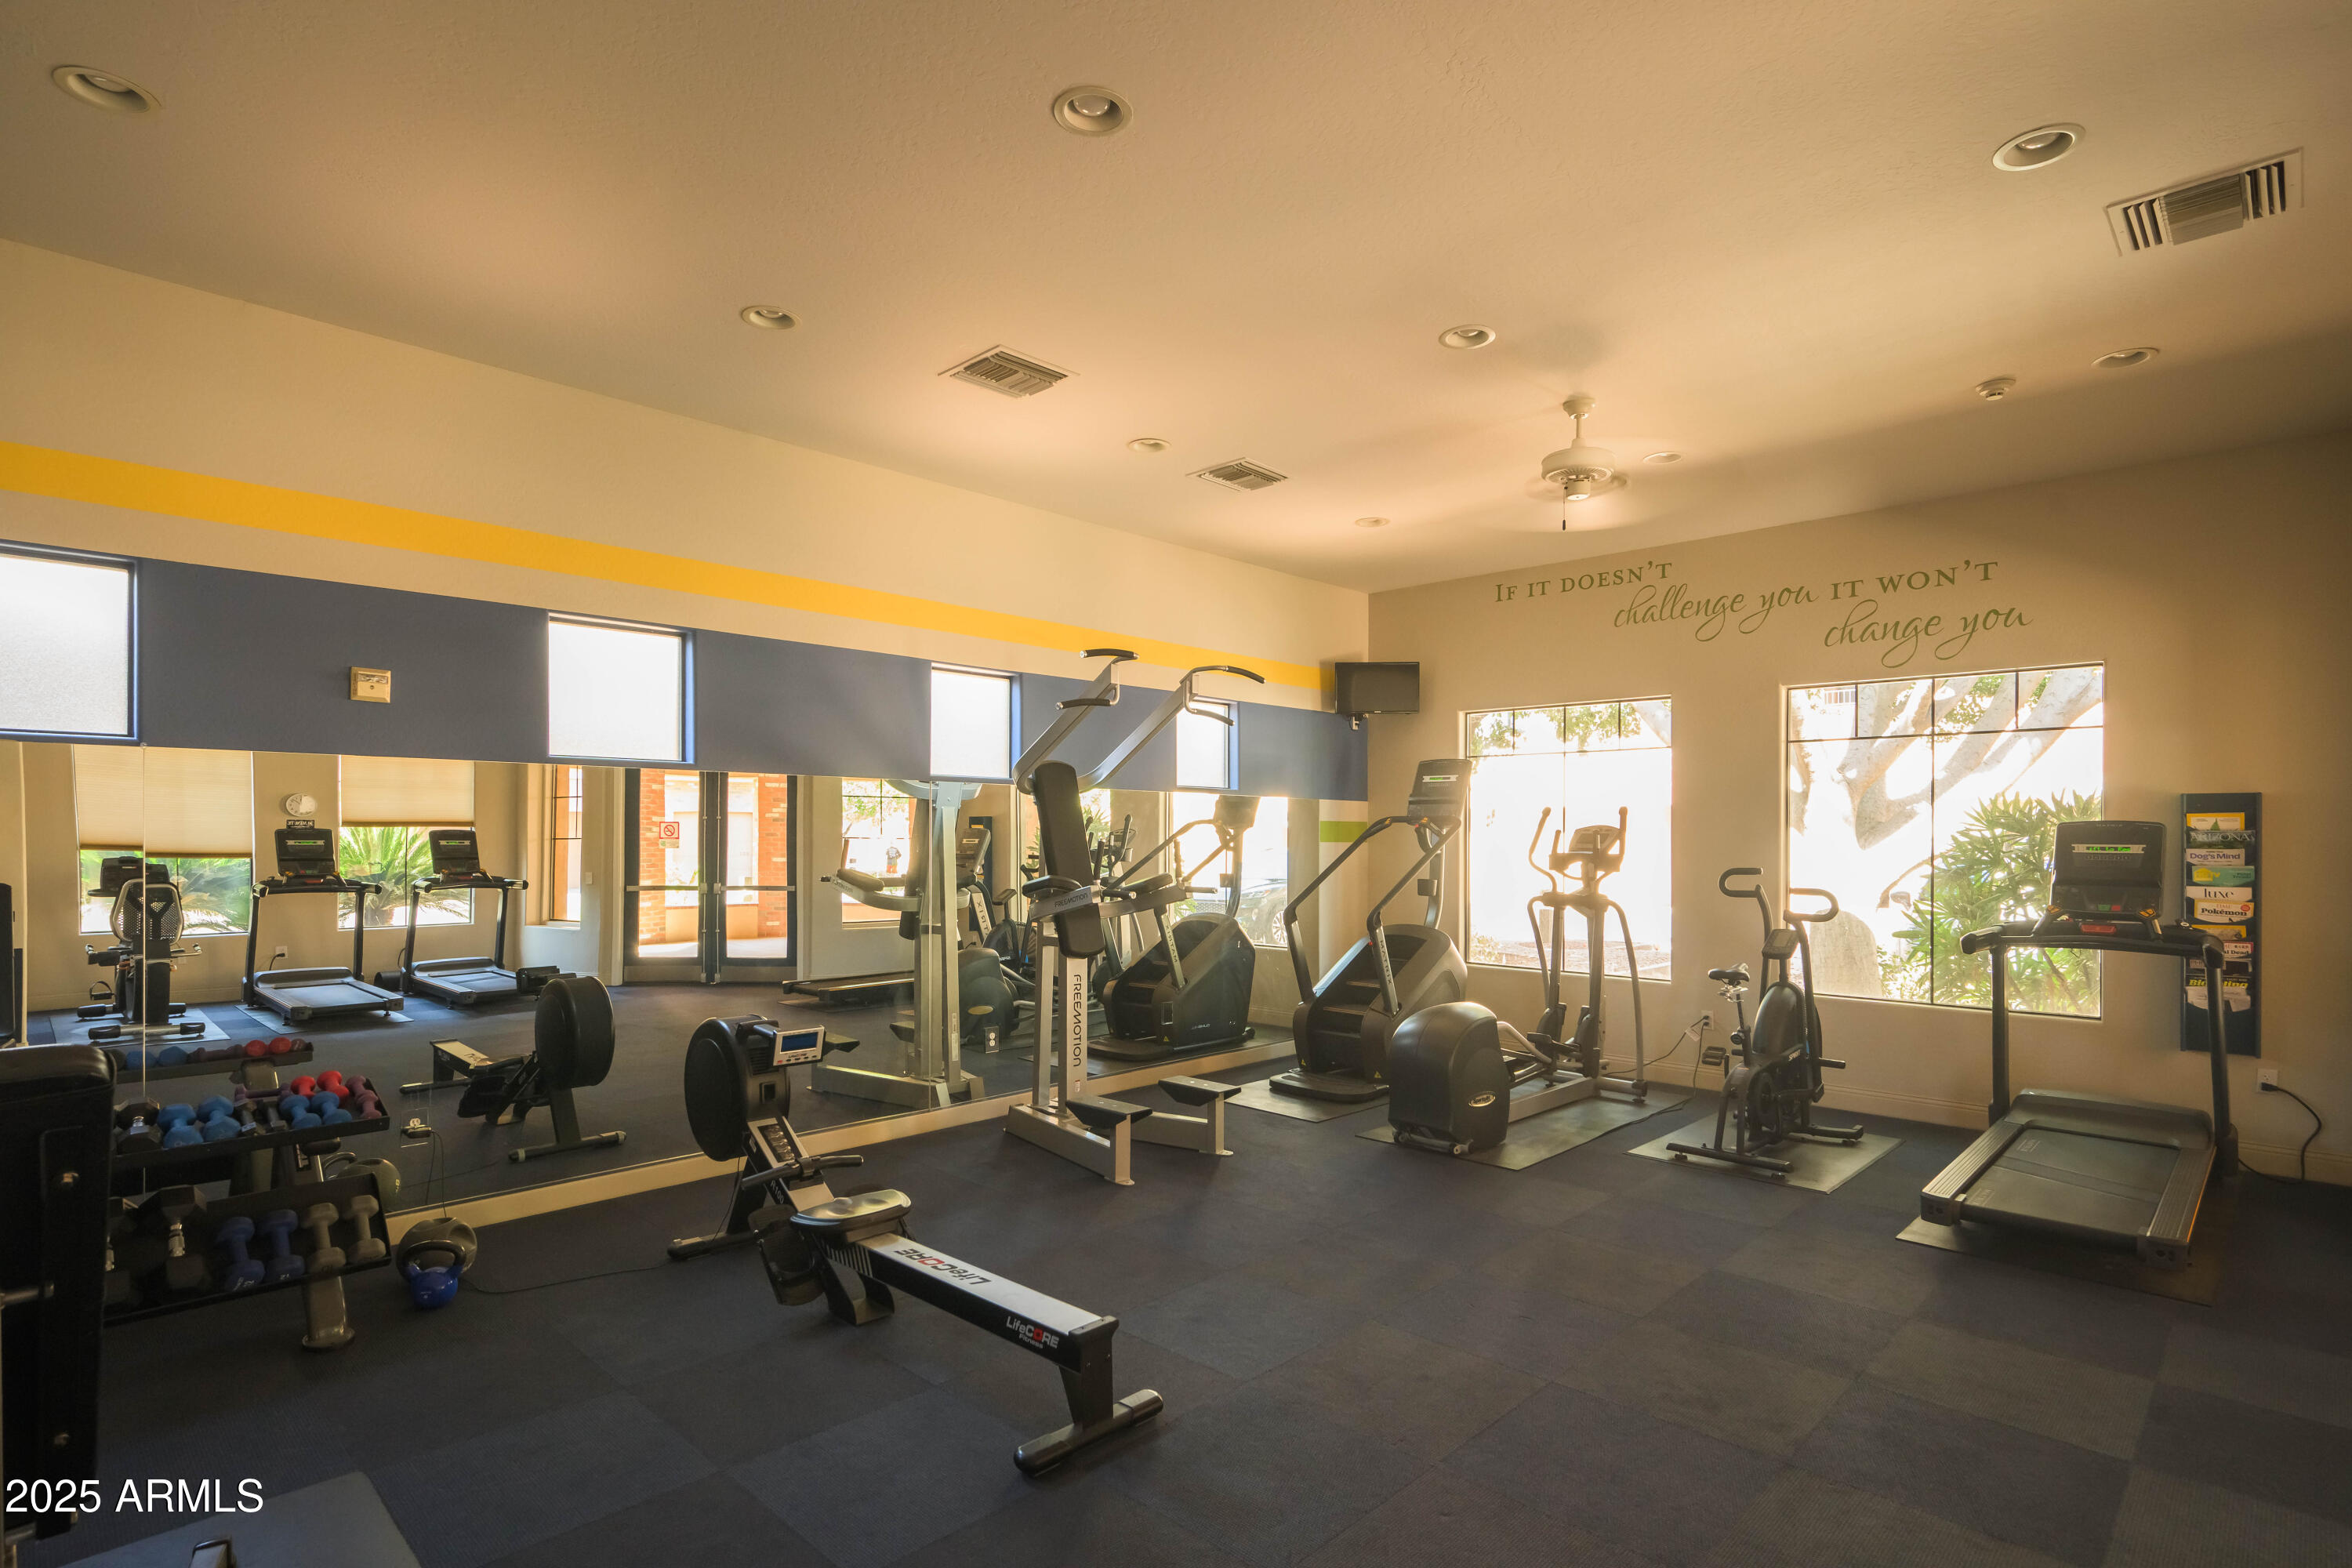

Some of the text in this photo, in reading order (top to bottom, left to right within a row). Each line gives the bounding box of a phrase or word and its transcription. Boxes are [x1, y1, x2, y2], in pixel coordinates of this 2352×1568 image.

[1527, 580, 1551, 597] IT
[1561, 560, 1672, 593] DOESN'T
[1613, 559, 1998, 641] challenge you IT WON'T
[1824, 599, 2032, 668] change you
[2189, 832, 2250, 841] ARIZONA
[1054, 892, 1088, 908] FREEMOTION
[2201, 907, 2248, 916] Pokémon
[1380, 940, 1392, 985] MATRIX
[2189, 979, 2249, 989] Bicling
[1073, 974, 1082, 1067] FREEMOTION
[894, 1248, 992, 1285] LifeCORE
[1006, 1316, 1060, 1348] LifeCORE
[1018, 1334, 1044, 1349] Fitness
